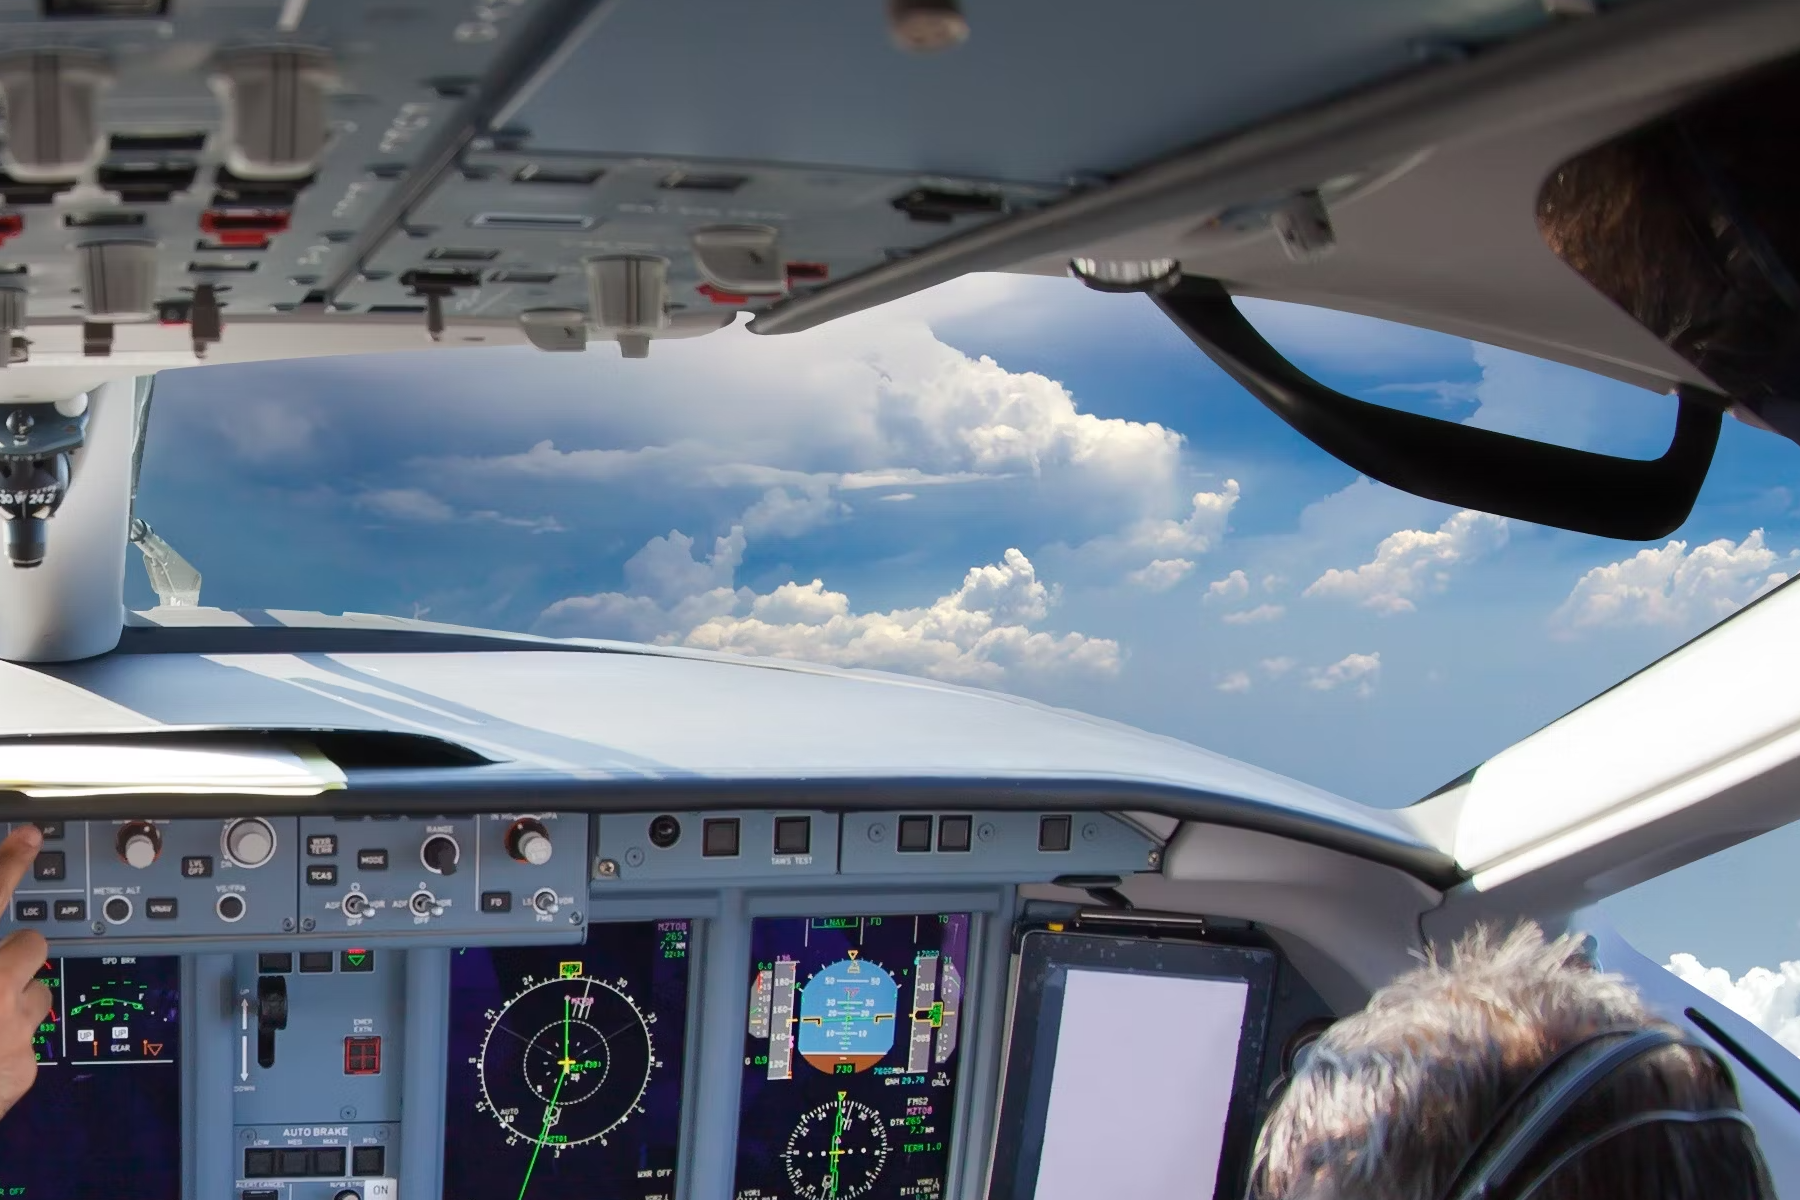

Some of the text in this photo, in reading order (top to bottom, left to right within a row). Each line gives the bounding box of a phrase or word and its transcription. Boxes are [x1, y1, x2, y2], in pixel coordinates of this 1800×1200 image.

[870, 918, 882, 926] FD
[617, 978, 628, 988] 30
[836, 1065, 852, 1073] 730
[283, 1127, 348, 1137] AUTO BRAKE
[373, 1185, 388, 1194] ON
